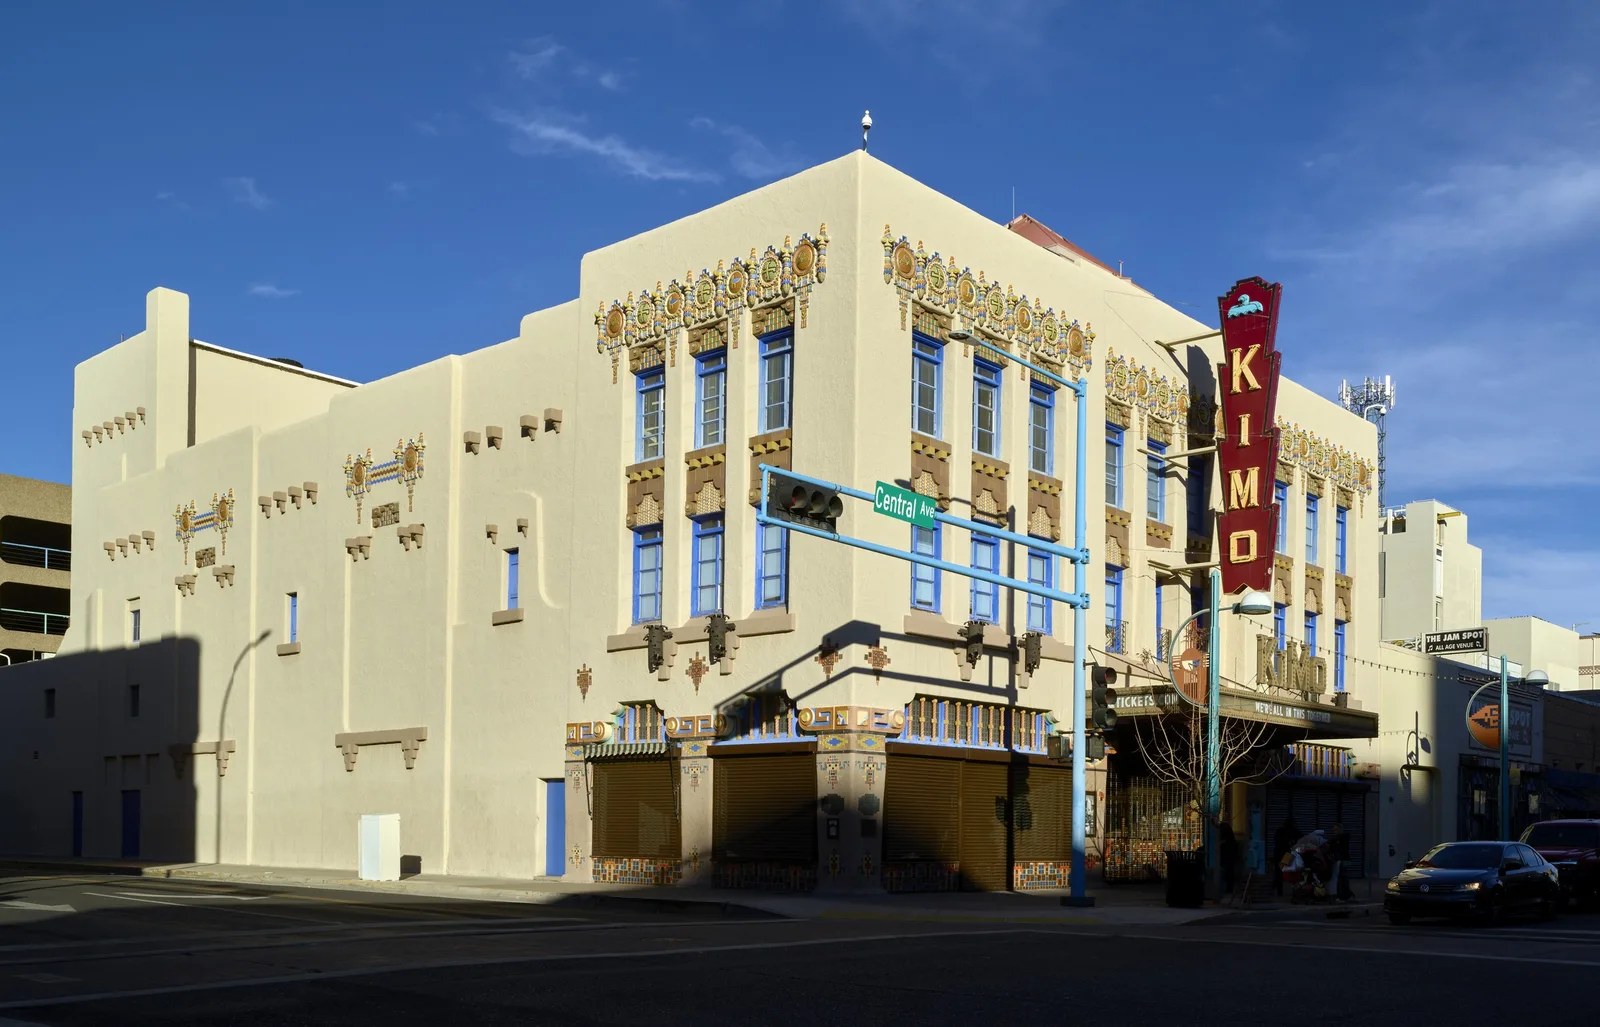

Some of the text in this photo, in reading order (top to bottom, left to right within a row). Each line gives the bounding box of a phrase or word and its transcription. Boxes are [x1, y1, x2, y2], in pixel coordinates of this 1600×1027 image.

[1228, 343, 1262, 564] KIMO
[875, 486, 935, 519] Central Ave
[1426, 631, 1484, 643] THE JAM SPOT
[1256, 634, 1327, 694] KIMO
[1273, 705, 1284, 716] ALL
[1293, 708, 1305, 719] THIS
